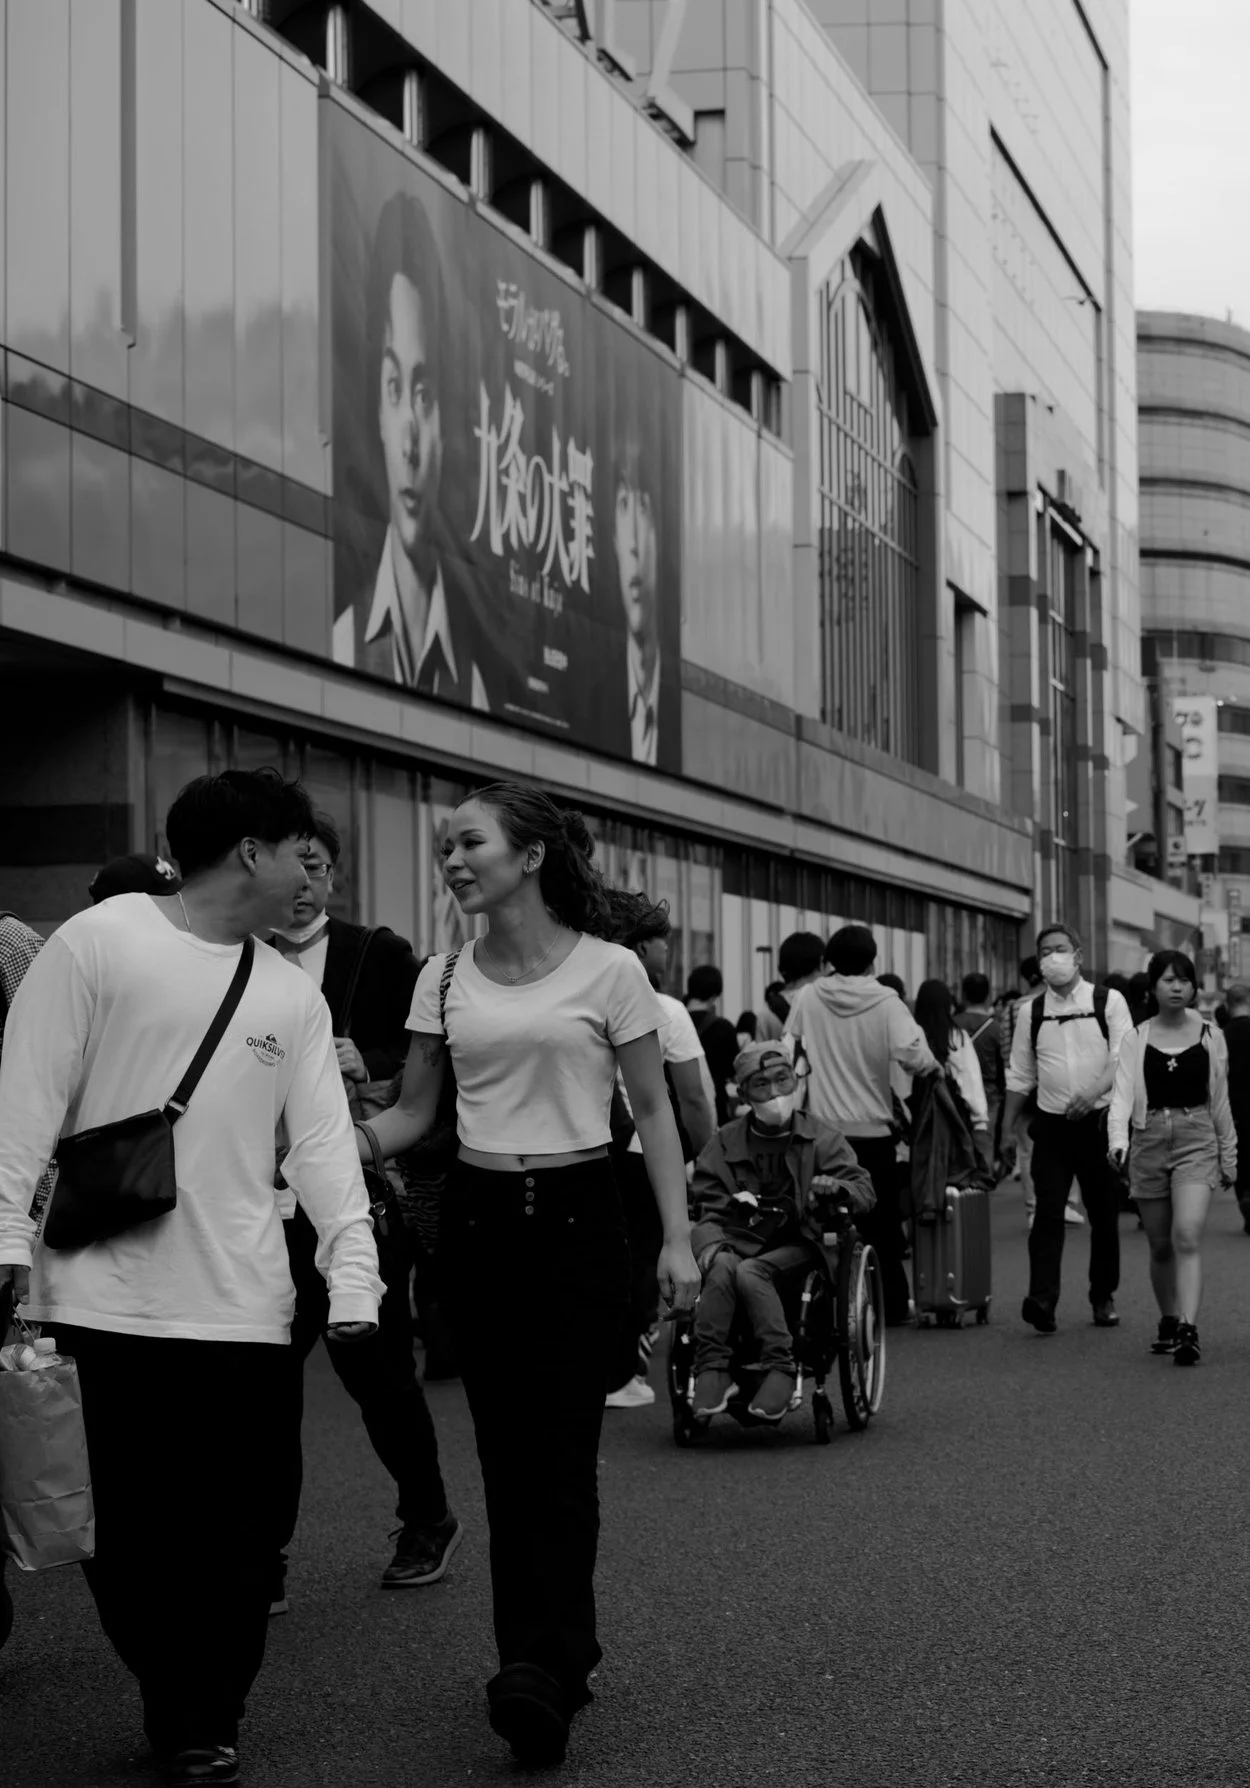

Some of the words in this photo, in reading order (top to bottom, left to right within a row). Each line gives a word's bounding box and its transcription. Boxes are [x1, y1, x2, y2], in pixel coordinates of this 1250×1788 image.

[469, 378, 595, 595] 九条の大罪
[246, 1036, 286, 1061] QUIKSILV
